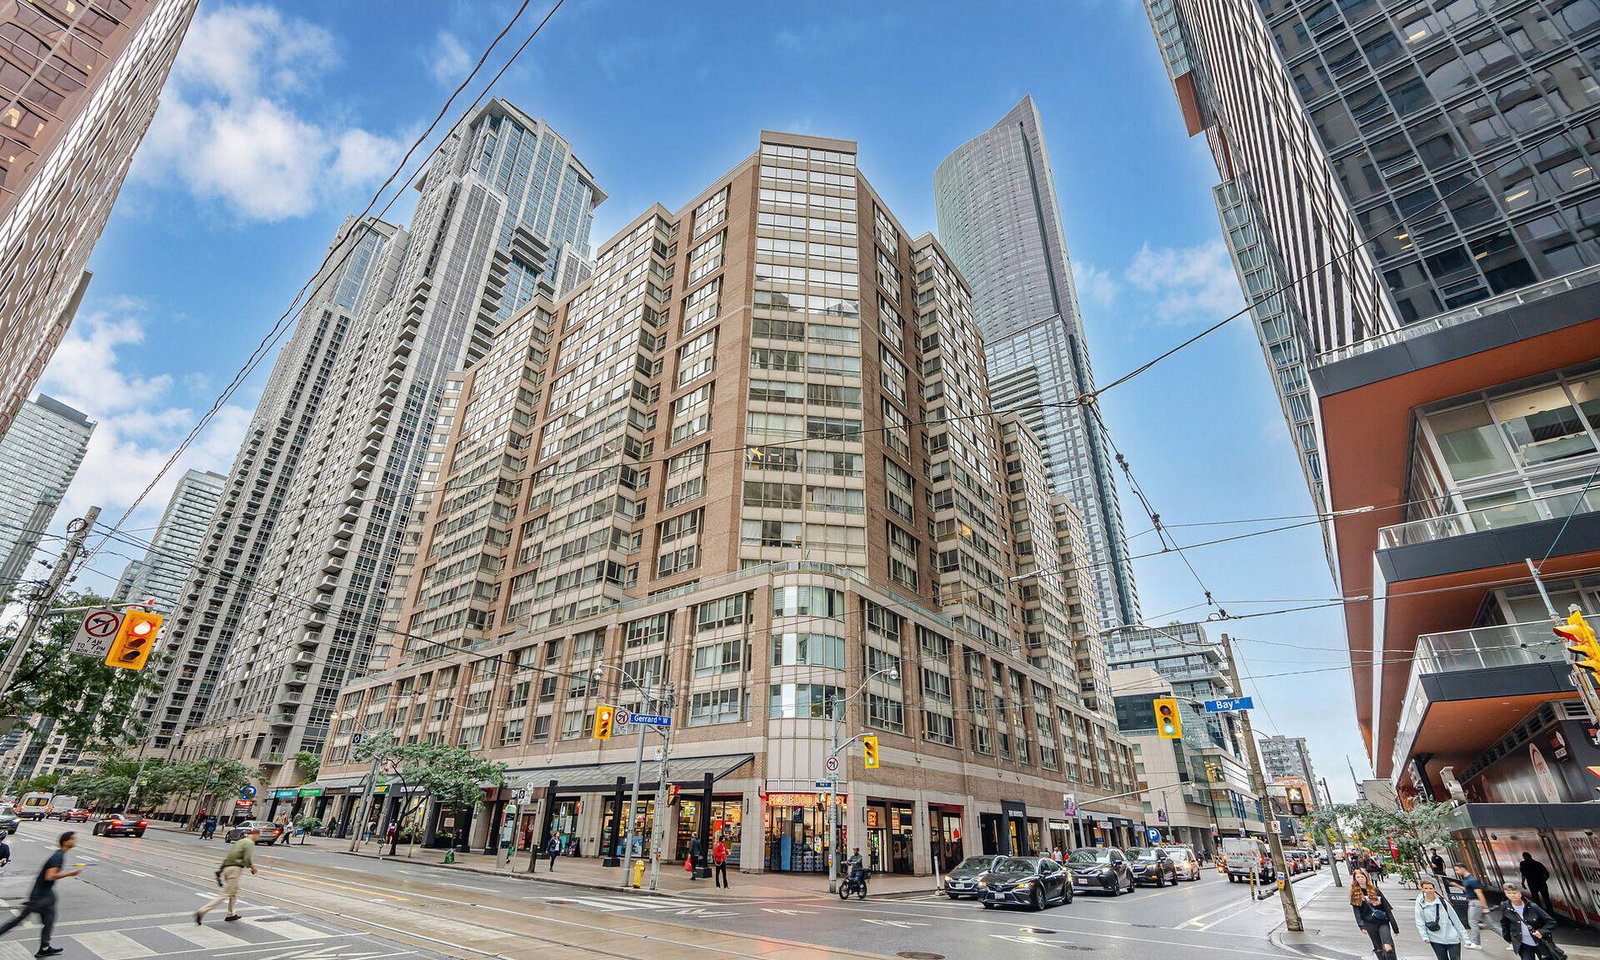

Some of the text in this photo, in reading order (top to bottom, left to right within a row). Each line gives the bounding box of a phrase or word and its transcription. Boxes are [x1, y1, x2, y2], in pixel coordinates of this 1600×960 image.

[1215, 700, 1234, 710] Bay
[633, 714, 658, 723] Gerrard
[789, 794, 813, 806] FOOD
[1149, 830, 1156, 841] P
